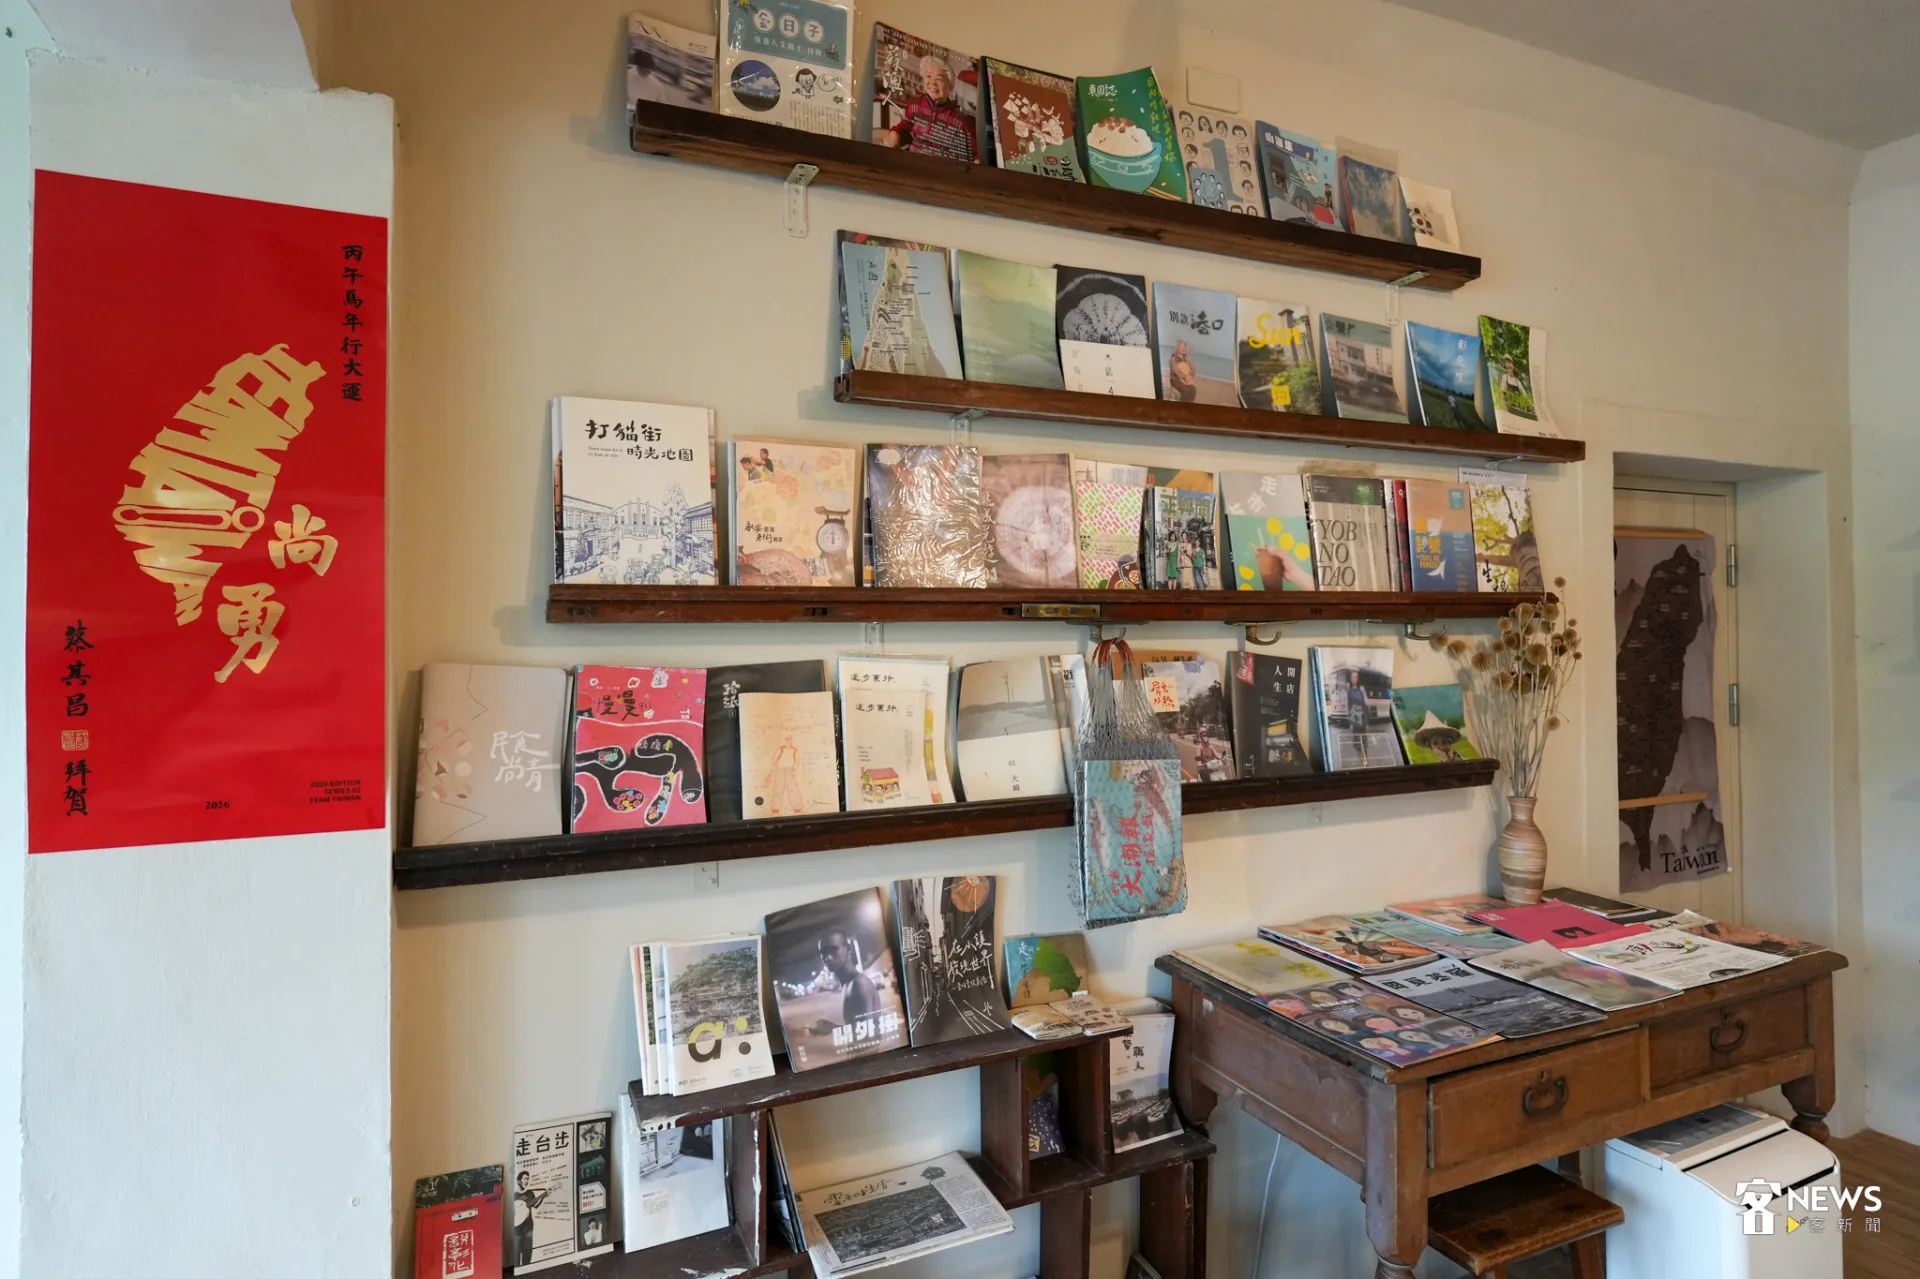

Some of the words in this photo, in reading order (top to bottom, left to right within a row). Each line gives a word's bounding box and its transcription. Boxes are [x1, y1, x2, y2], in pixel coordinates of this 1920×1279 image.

[341, 245, 364, 402] 丙午馬年行大運
[1248, 313, 1302, 348] Sun
[585, 419, 663, 442] 打貓街
[627, 445, 694, 462] 時光地圖
[1318, 543, 1350, 564] NO
[1320, 565, 1357, 588] TAO
[61, 619, 95, 718] 蔡其昌
[1273, 665, 1283, 693] 人生
[63, 758, 93, 817] 拜賀
[205, 799, 231, 810] 2026
[516, 1131, 569, 1158] 走台步
